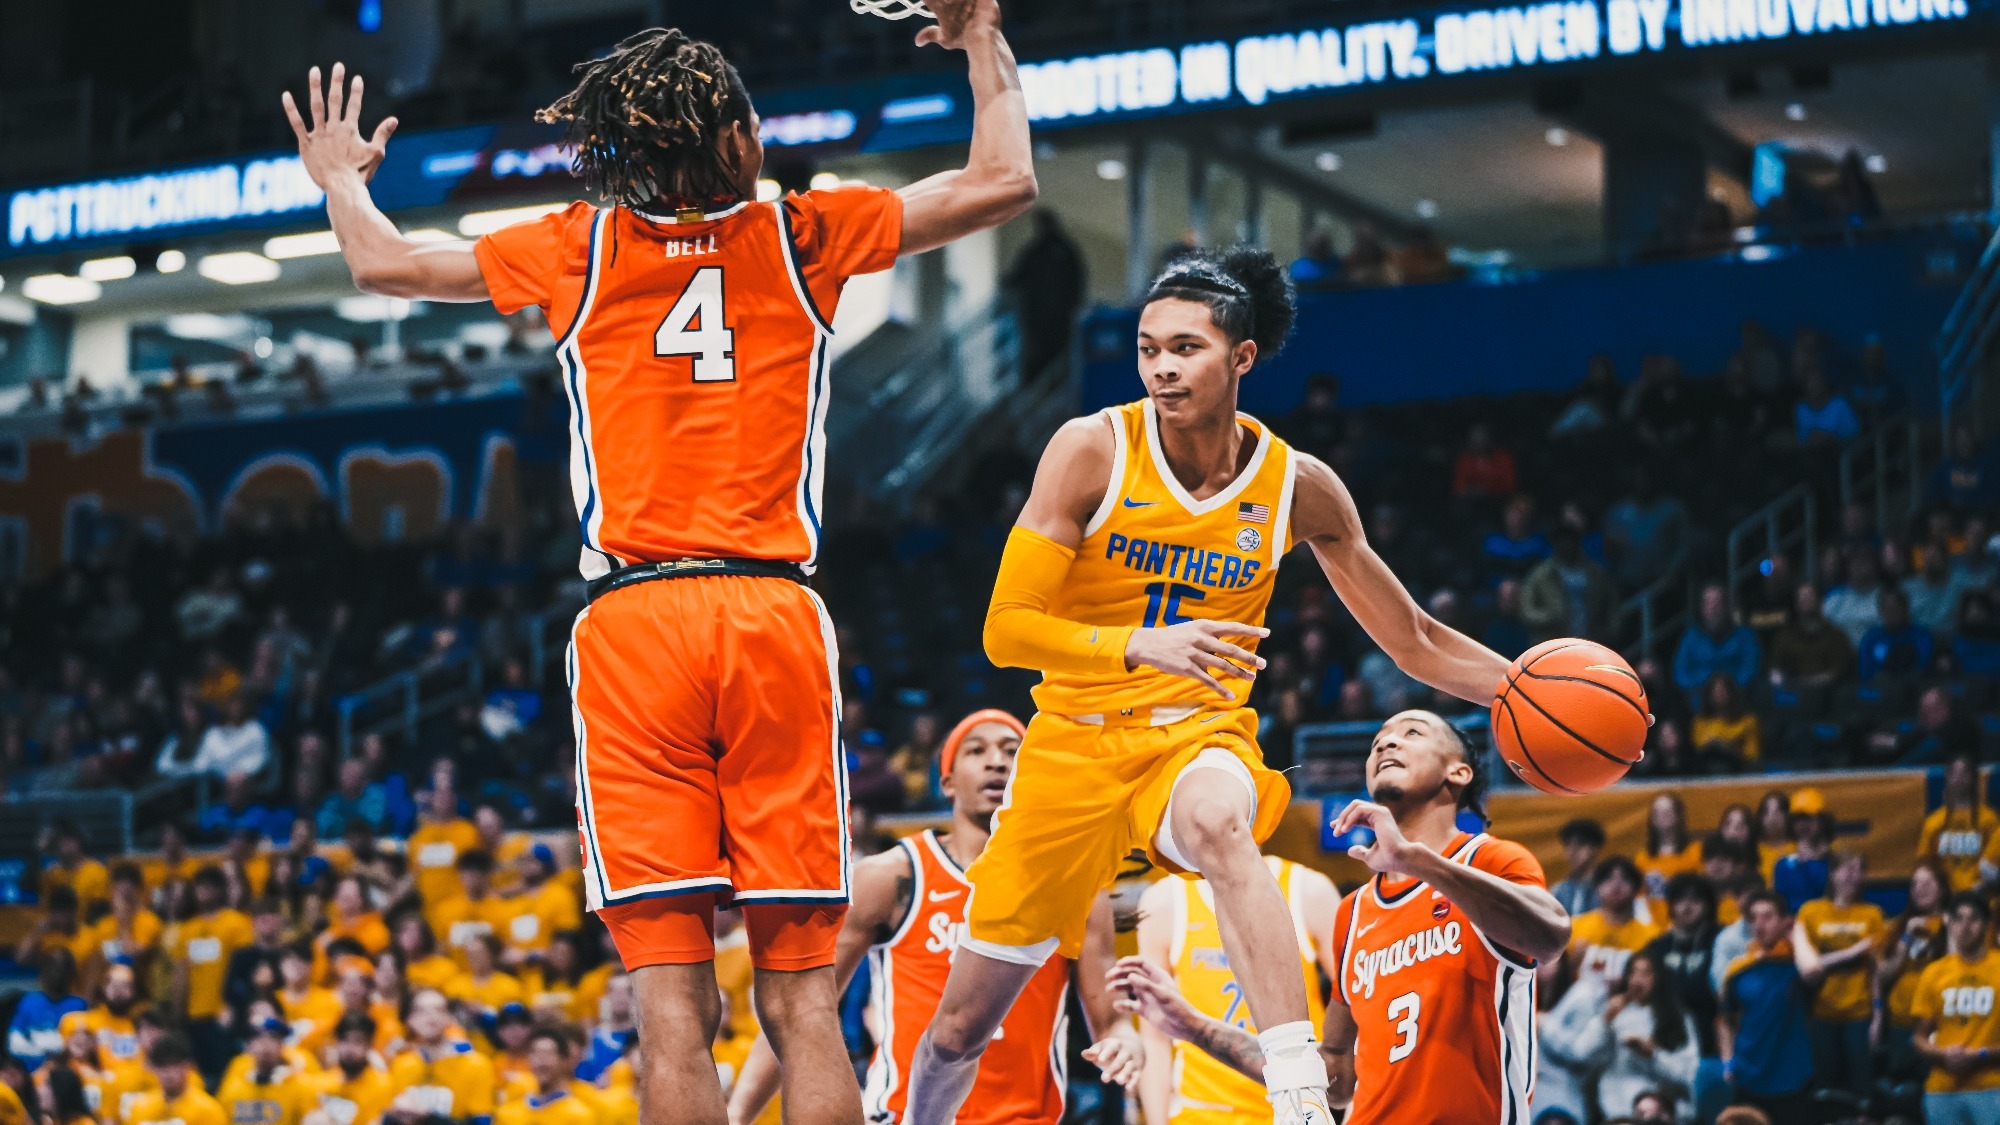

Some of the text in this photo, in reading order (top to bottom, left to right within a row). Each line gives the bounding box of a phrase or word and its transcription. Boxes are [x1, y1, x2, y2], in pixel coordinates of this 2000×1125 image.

[1180, 42, 1230, 102] IN
[1236, 19, 1429, 104] QUALITY.
[1434, 1, 1599, 73] DRIVEN
[1607, 0, 1668, 53] BY
[665, 234, 719, 258] BELL
[654, 266, 736, 383] 4
[1106, 533, 1261, 588] PANTHERS
[1142, 582, 1206, 628] 15
[1352, 921, 1462, 999] Syracuse
[1387, 991, 1420, 1064] 3
